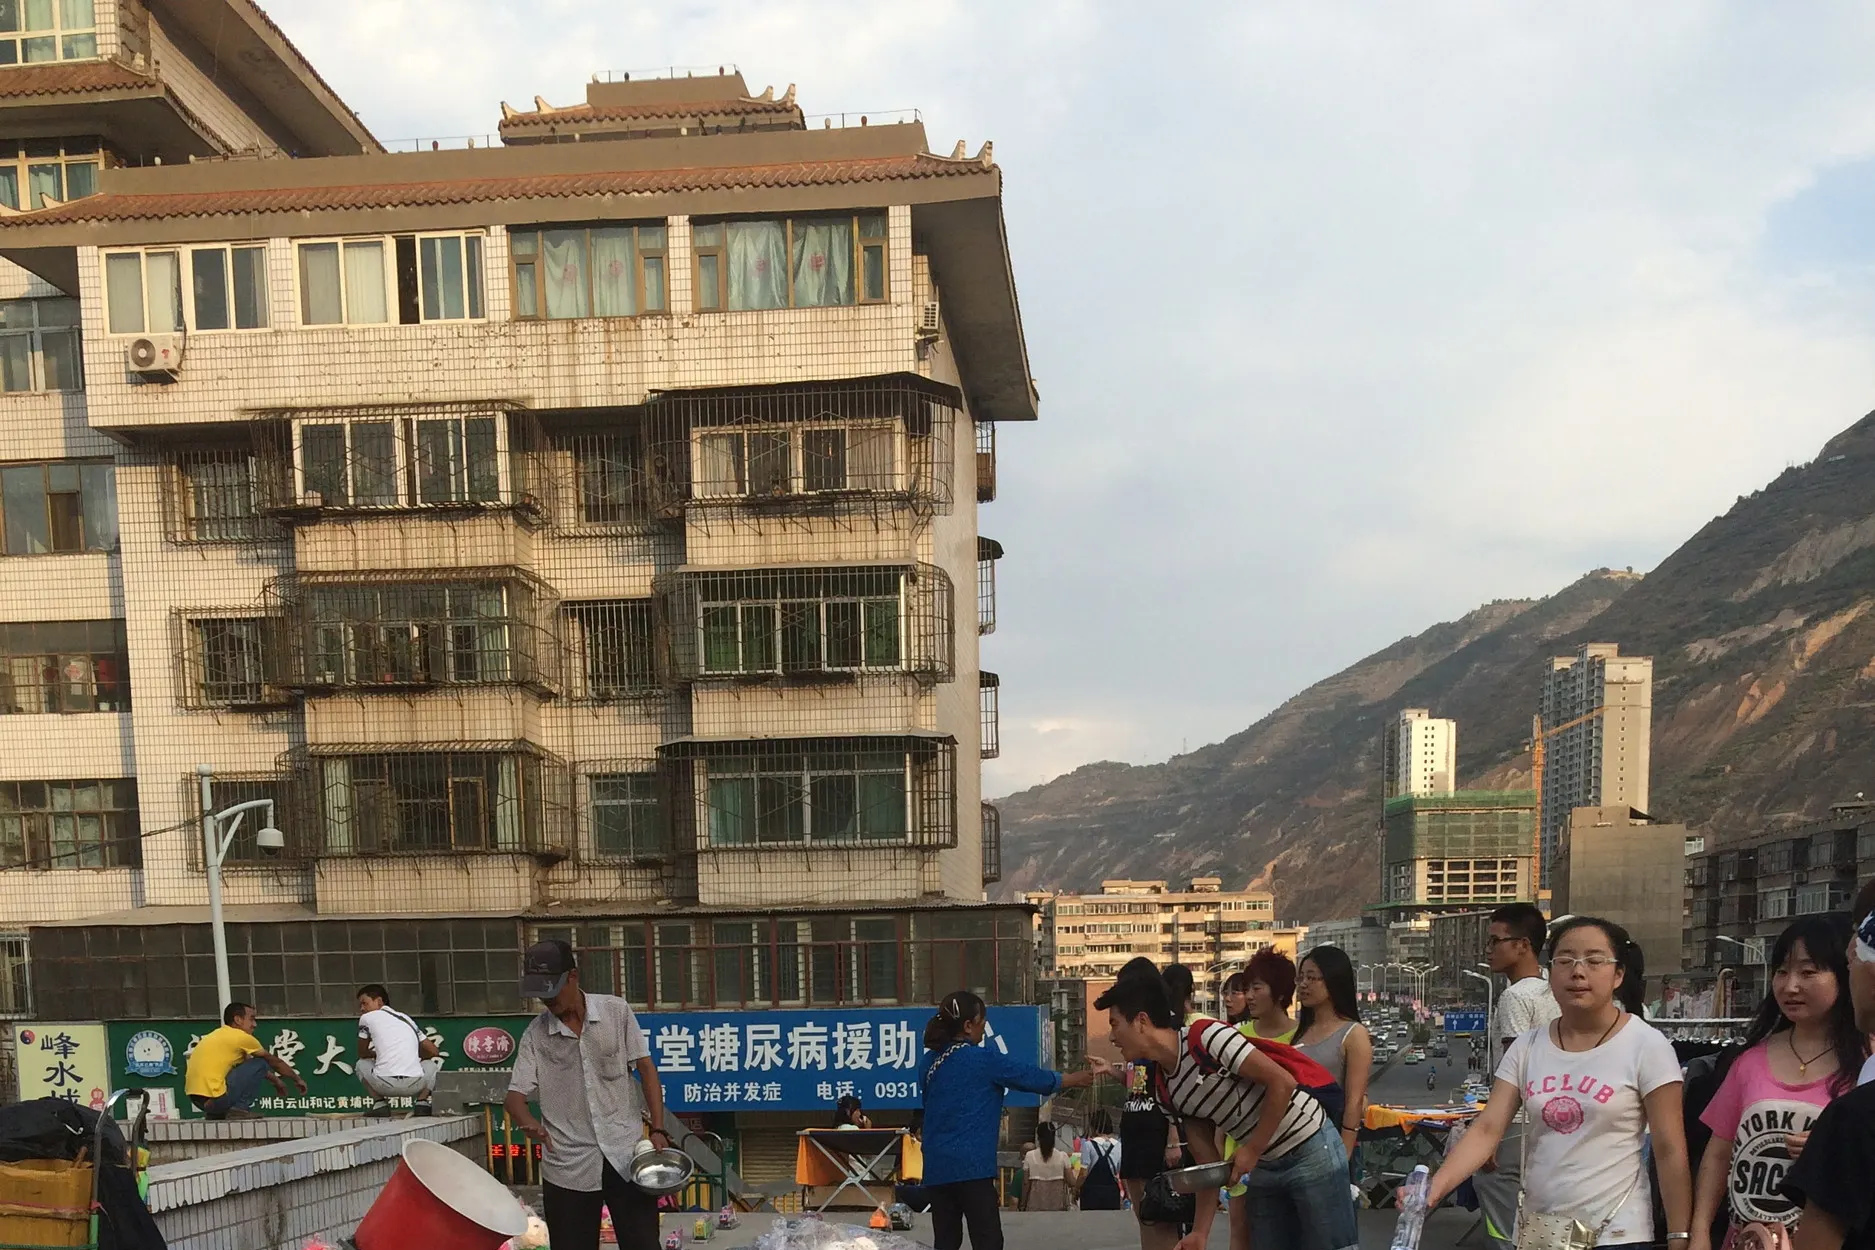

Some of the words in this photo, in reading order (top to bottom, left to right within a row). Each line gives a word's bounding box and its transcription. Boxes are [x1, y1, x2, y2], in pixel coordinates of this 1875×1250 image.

[684, 1081, 783, 1103] 防治并发症
[1741, 1109, 1796, 1138] YORK
[1733, 1159, 1793, 1197] SAC
